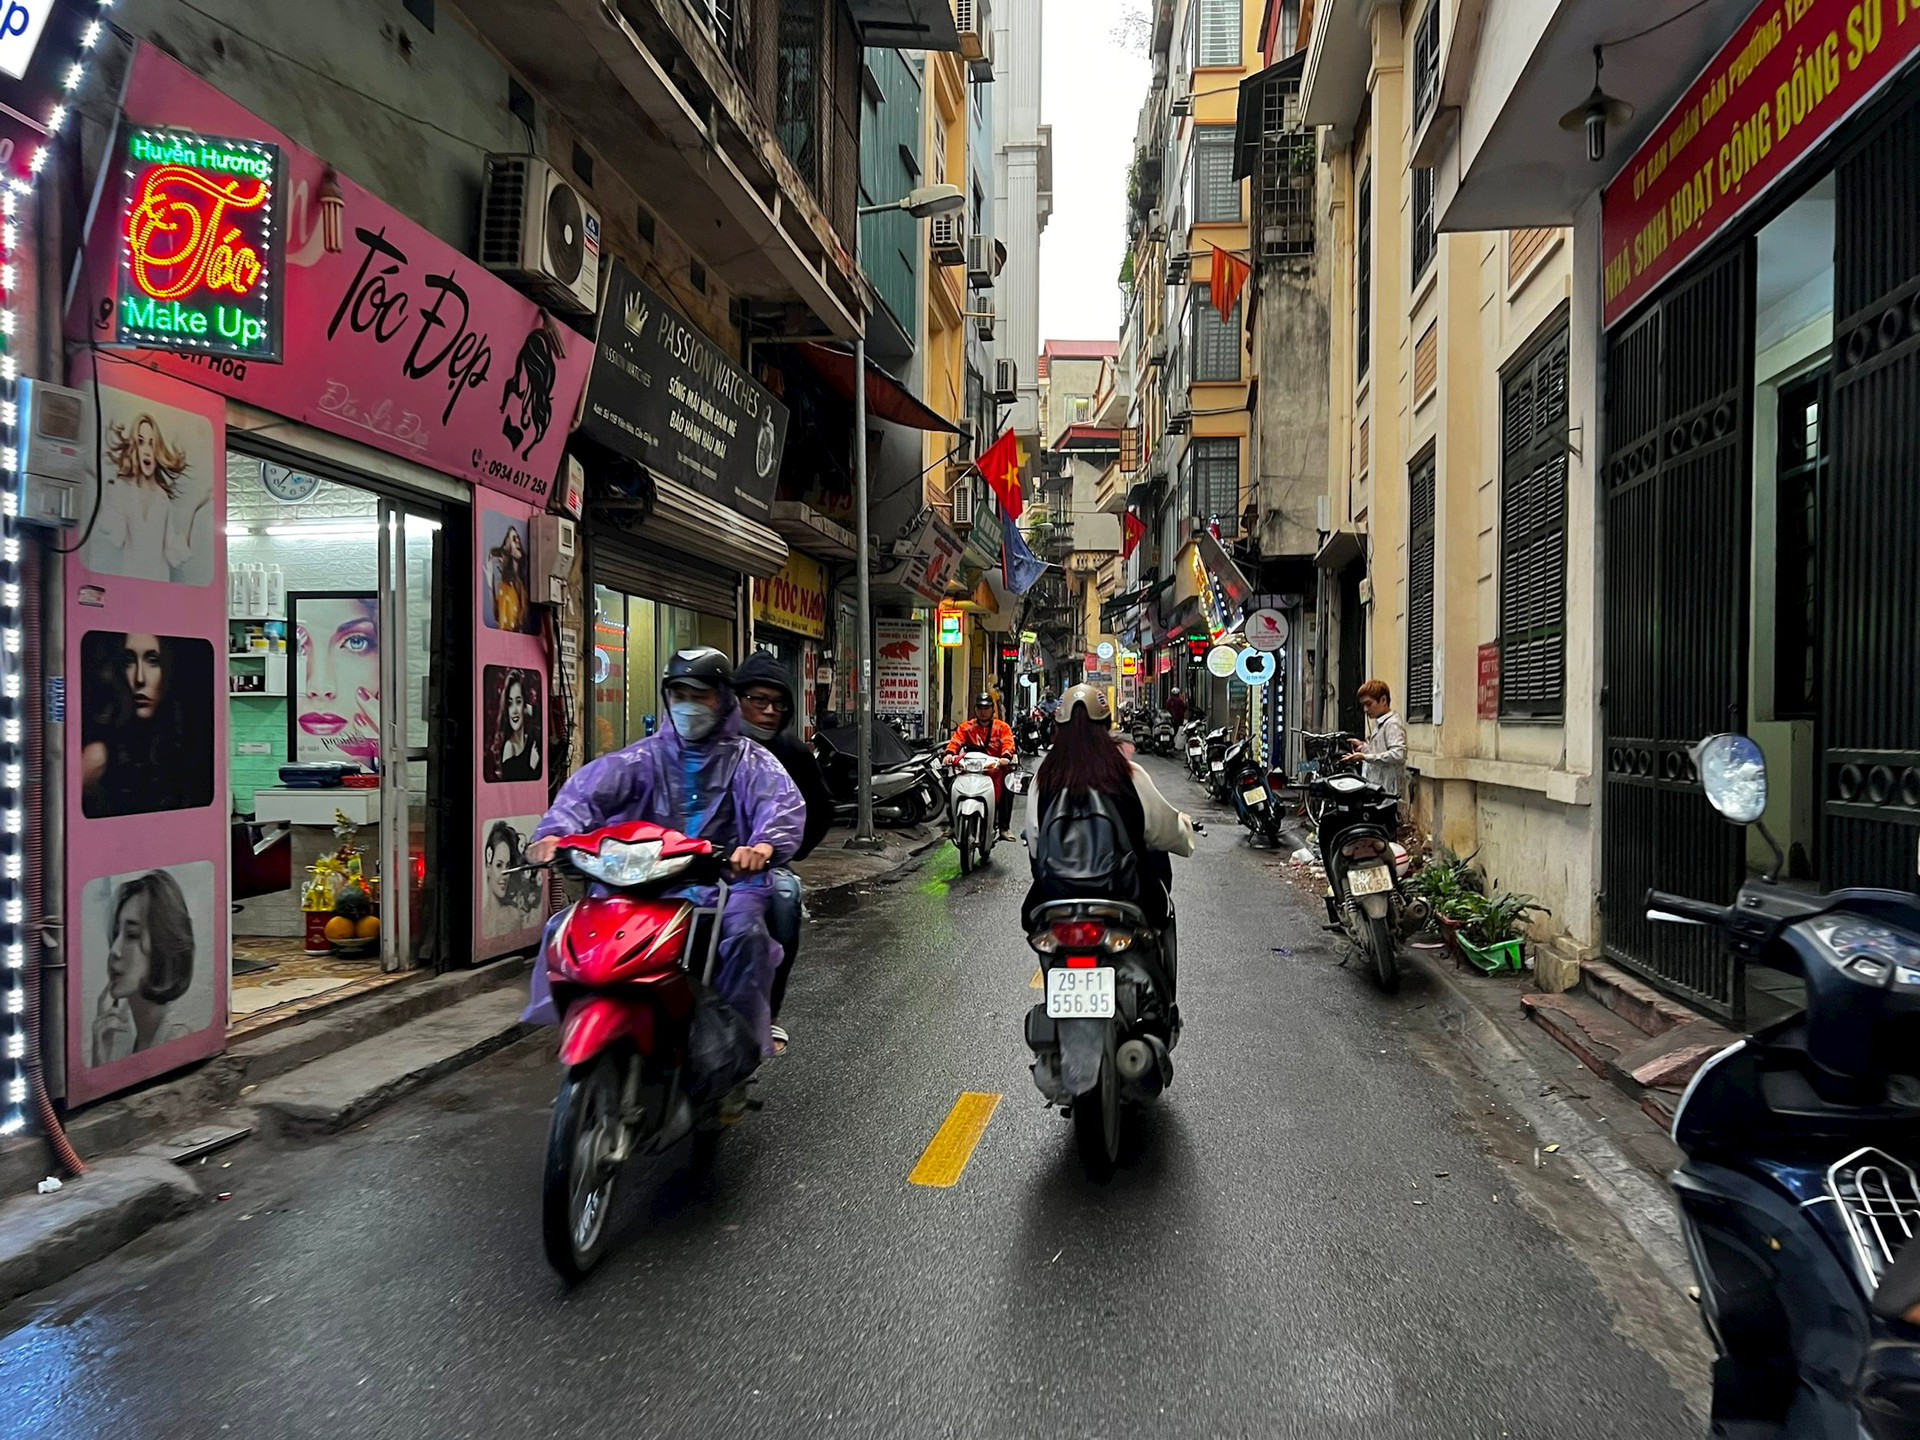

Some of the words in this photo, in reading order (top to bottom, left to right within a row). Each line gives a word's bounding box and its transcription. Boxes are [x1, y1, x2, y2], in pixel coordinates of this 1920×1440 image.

[1647, 141, 1668, 188] BAN
[1634, 206, 1669, 276] SINH
[1670, 157, 1715, 240] HOẠT
[1719, 102, 1772, 195] CỘNG
[126, 296, 208, 334] Make
[217, 304, 262, 347] Up
[327, 226, 409, 342] Tóc
[402, 269, 491, 427] Đẹp
[657, 311, 713, 383] PASSION
[712, 358, 760, 419] WATCHES
[488, 459, 513, 482] 0934
[512, 470, 531, 488] 617
[530, 477, 548, 495] 258
[774, 571, 799, 614] TÓC
[1052, 994, 1109, 1013] 556.95
[1058, 972, 1102, 991] 29-F1
